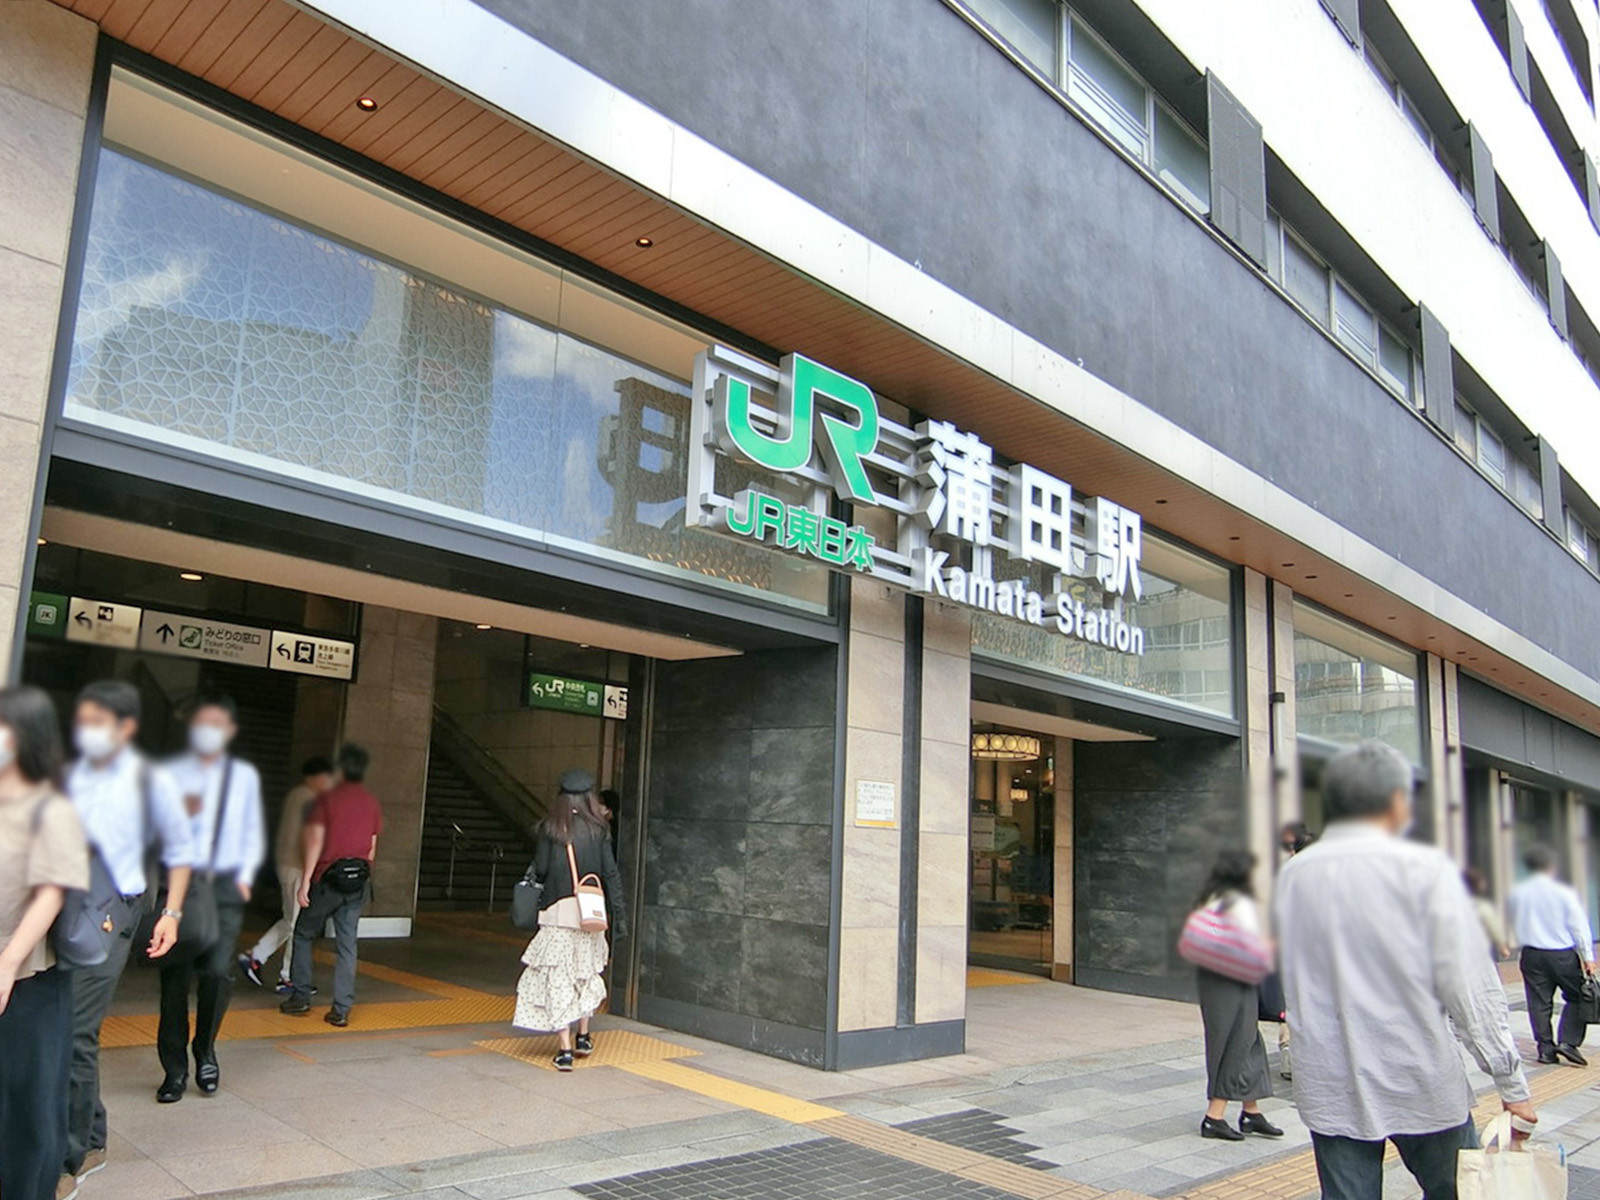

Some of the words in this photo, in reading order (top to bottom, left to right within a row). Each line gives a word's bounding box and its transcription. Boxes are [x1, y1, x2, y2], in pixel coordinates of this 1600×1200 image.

[722, 351, 880, 505] JR
[725, 489, 876, 573] JR東日本
[914, 418, 1143, 601] 蒲田駅
[204, 626, 262, 646] みどりの窓口
[924, 546, 1043, 627] Kamata
[1056, 591, 1145, 656] Station
[545, 679, 564, 695] JR
